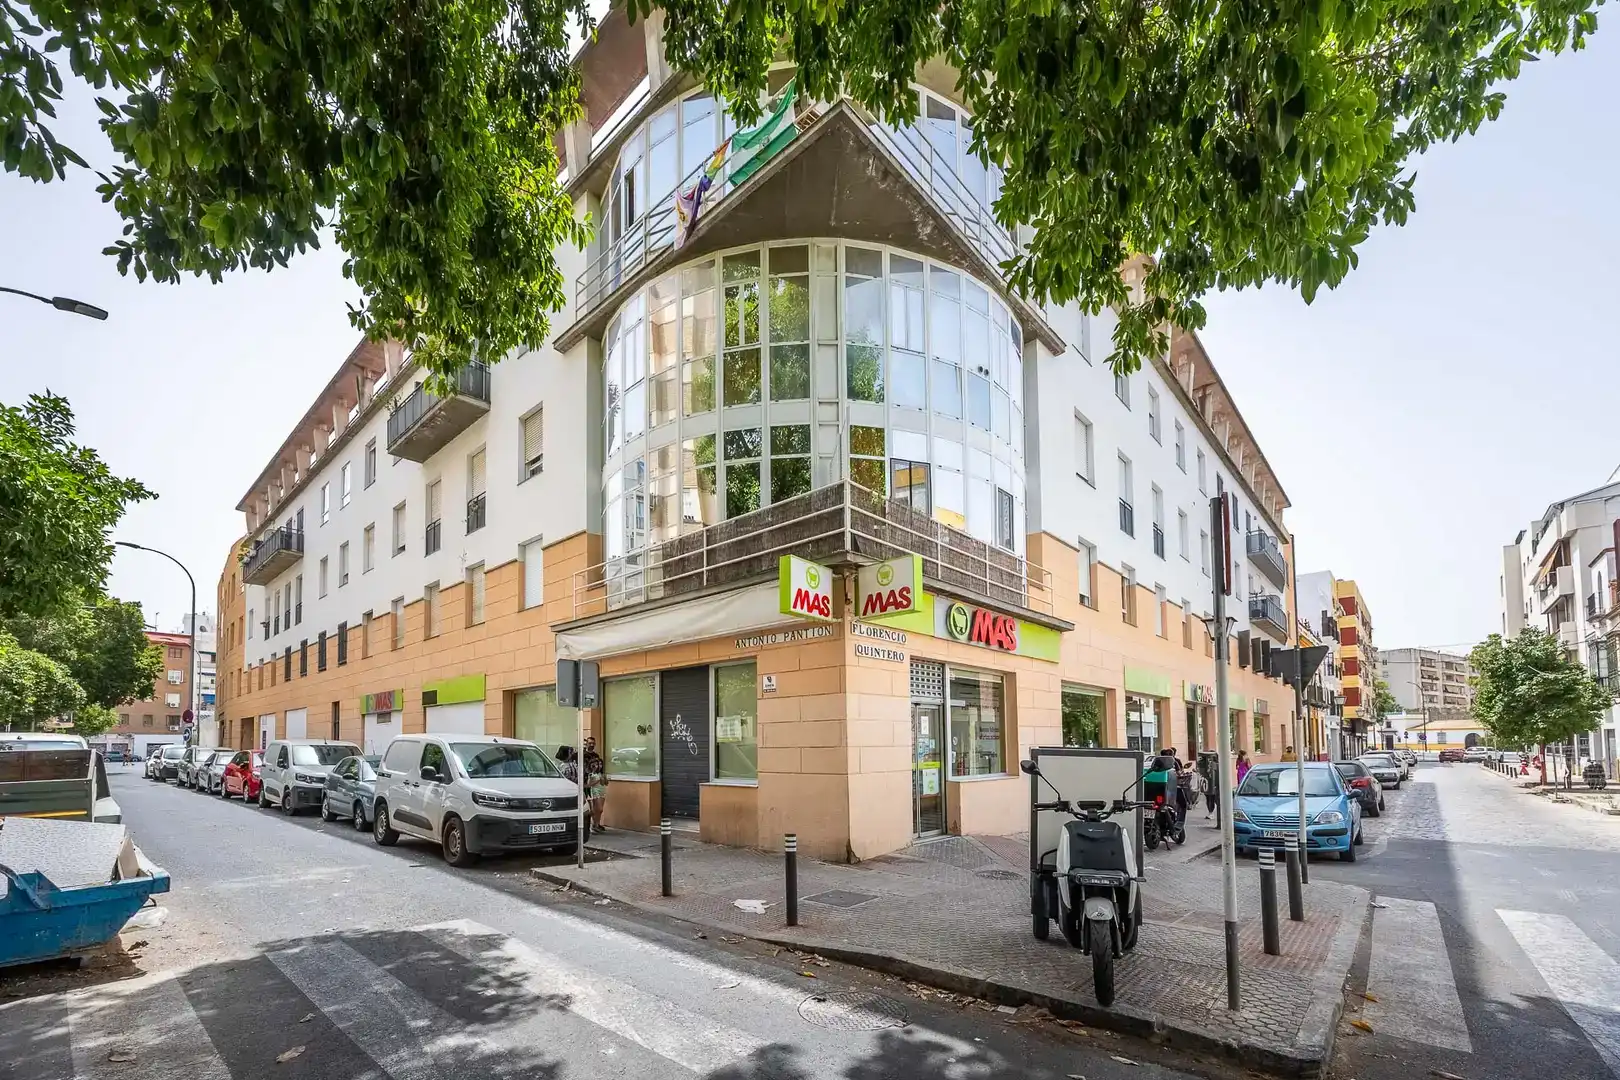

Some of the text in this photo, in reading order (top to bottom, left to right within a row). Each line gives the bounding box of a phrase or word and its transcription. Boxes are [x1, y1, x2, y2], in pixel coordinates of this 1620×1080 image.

[792, 588, 831, 618] MAS
[862, 586, 912, 617] MAS
[852, 623, 907, 644] FLORENCIO
[971, 608, 1017, 652] MAS
[735, 633, 777, 649] ANTONIO
[856, 644, 905, 662] QUINTERO
[375, 690, 393, 711] MAS
[533, 825, 551, 833] 5310
